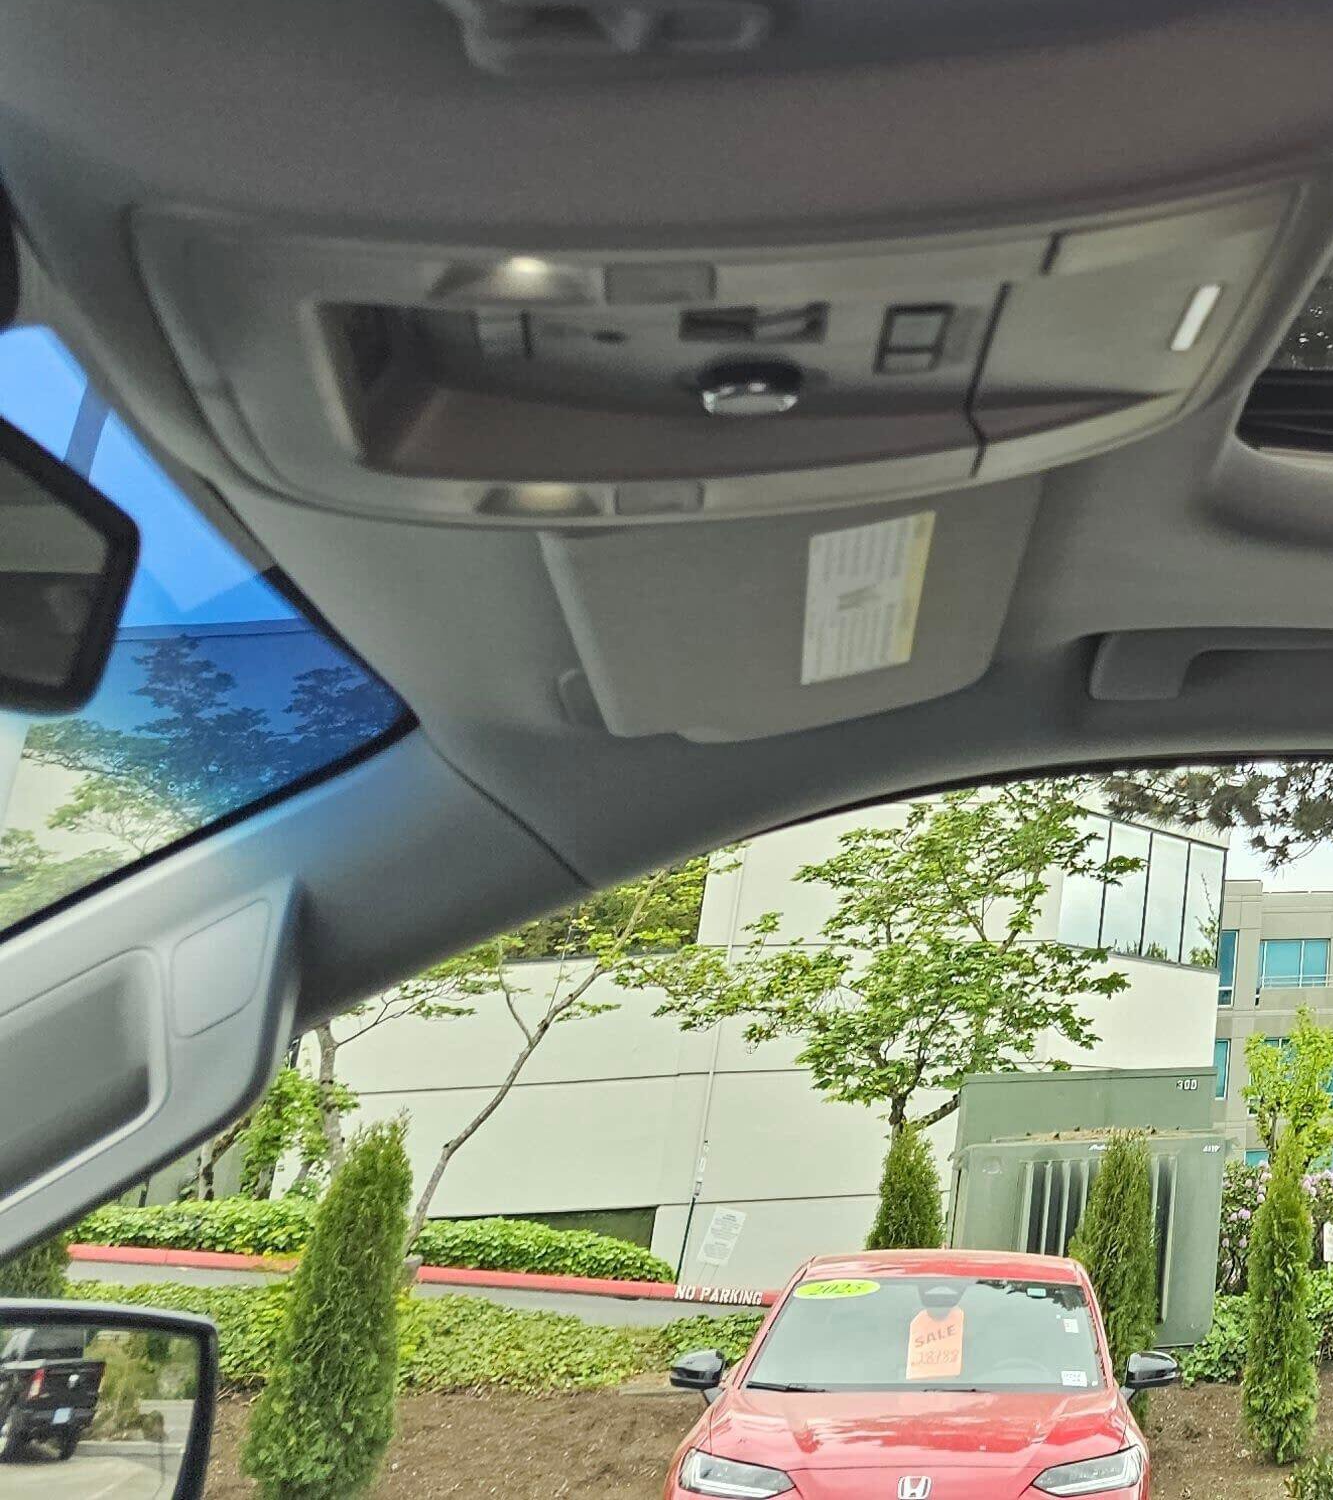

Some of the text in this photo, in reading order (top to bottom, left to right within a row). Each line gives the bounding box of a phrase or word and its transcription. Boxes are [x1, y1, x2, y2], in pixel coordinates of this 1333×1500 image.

[674, 1284, 763, 1305] NO PARKING
[914, 1324, 957, 1348] SALE
